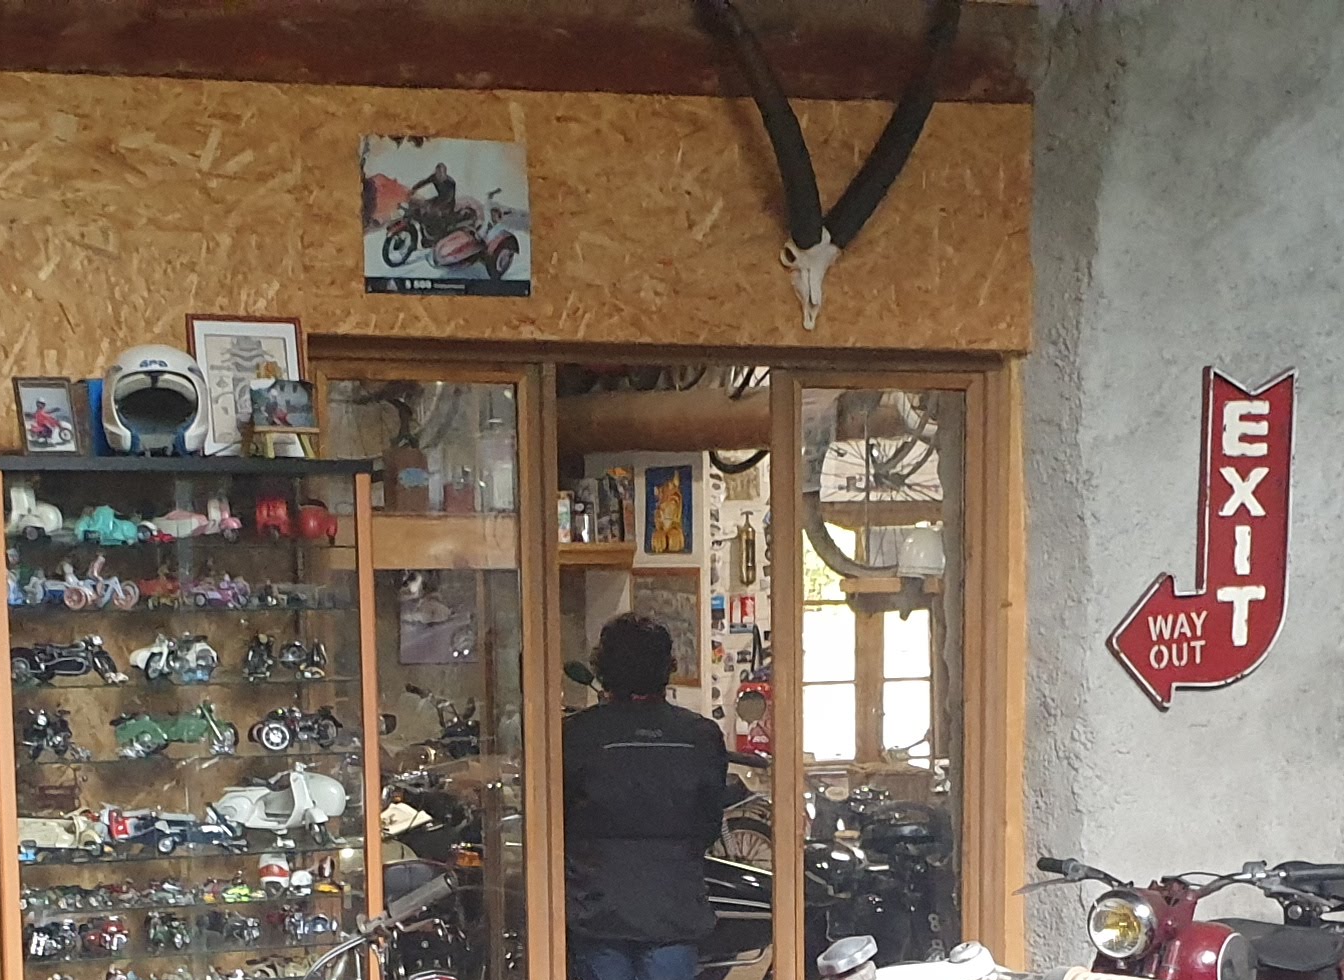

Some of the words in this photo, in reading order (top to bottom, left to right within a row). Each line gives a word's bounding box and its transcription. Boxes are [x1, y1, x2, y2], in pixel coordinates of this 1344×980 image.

[1216, 399, 1271, 647] EXIT
[1147, 610, 1209, 642] WAY
[1148, 640, 1206, 669] OUT
